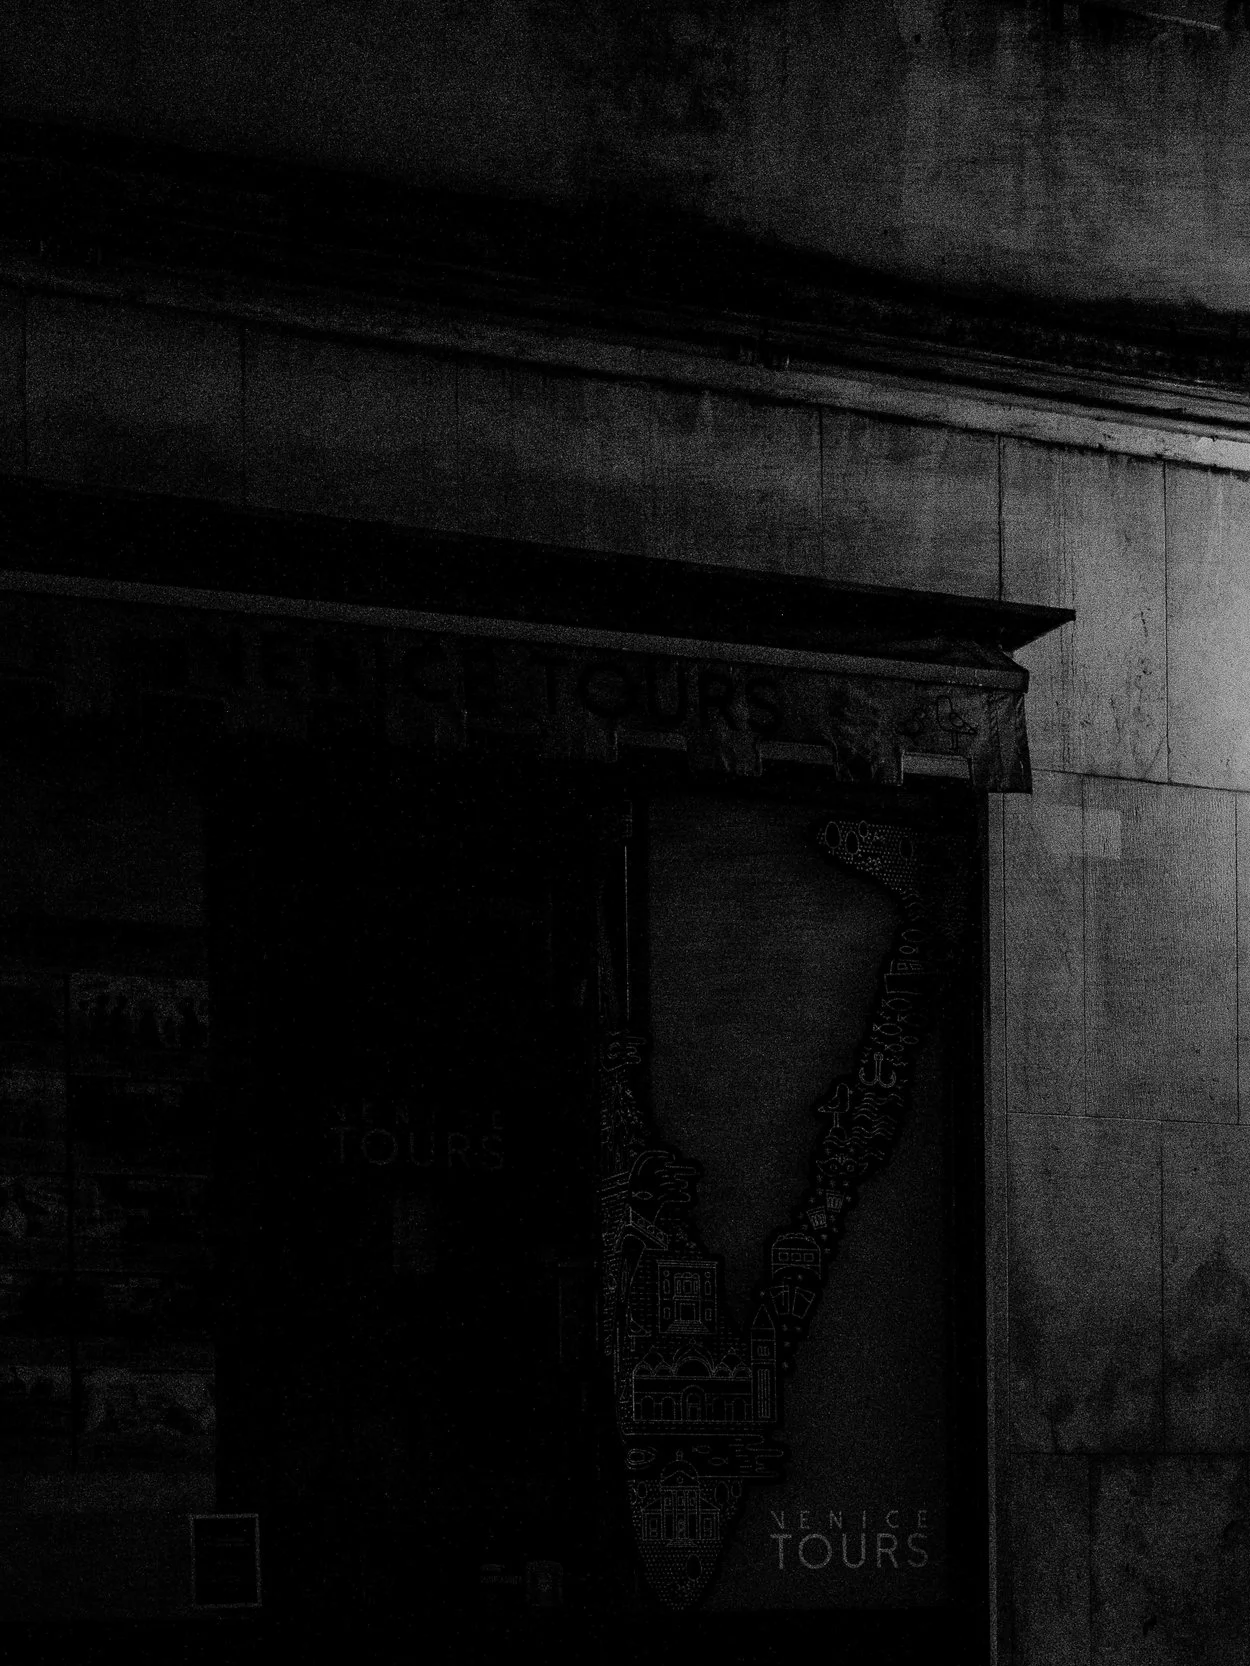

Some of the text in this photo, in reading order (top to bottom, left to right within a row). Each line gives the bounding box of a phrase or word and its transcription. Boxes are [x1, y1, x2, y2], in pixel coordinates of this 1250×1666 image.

[528, 652, 782, 736] TOURS
[329, 1124, 506, 1174] TOURS
[769, 1509, 928, 1530] VENICE
[769, 1532, 929, 1570] TOURS
